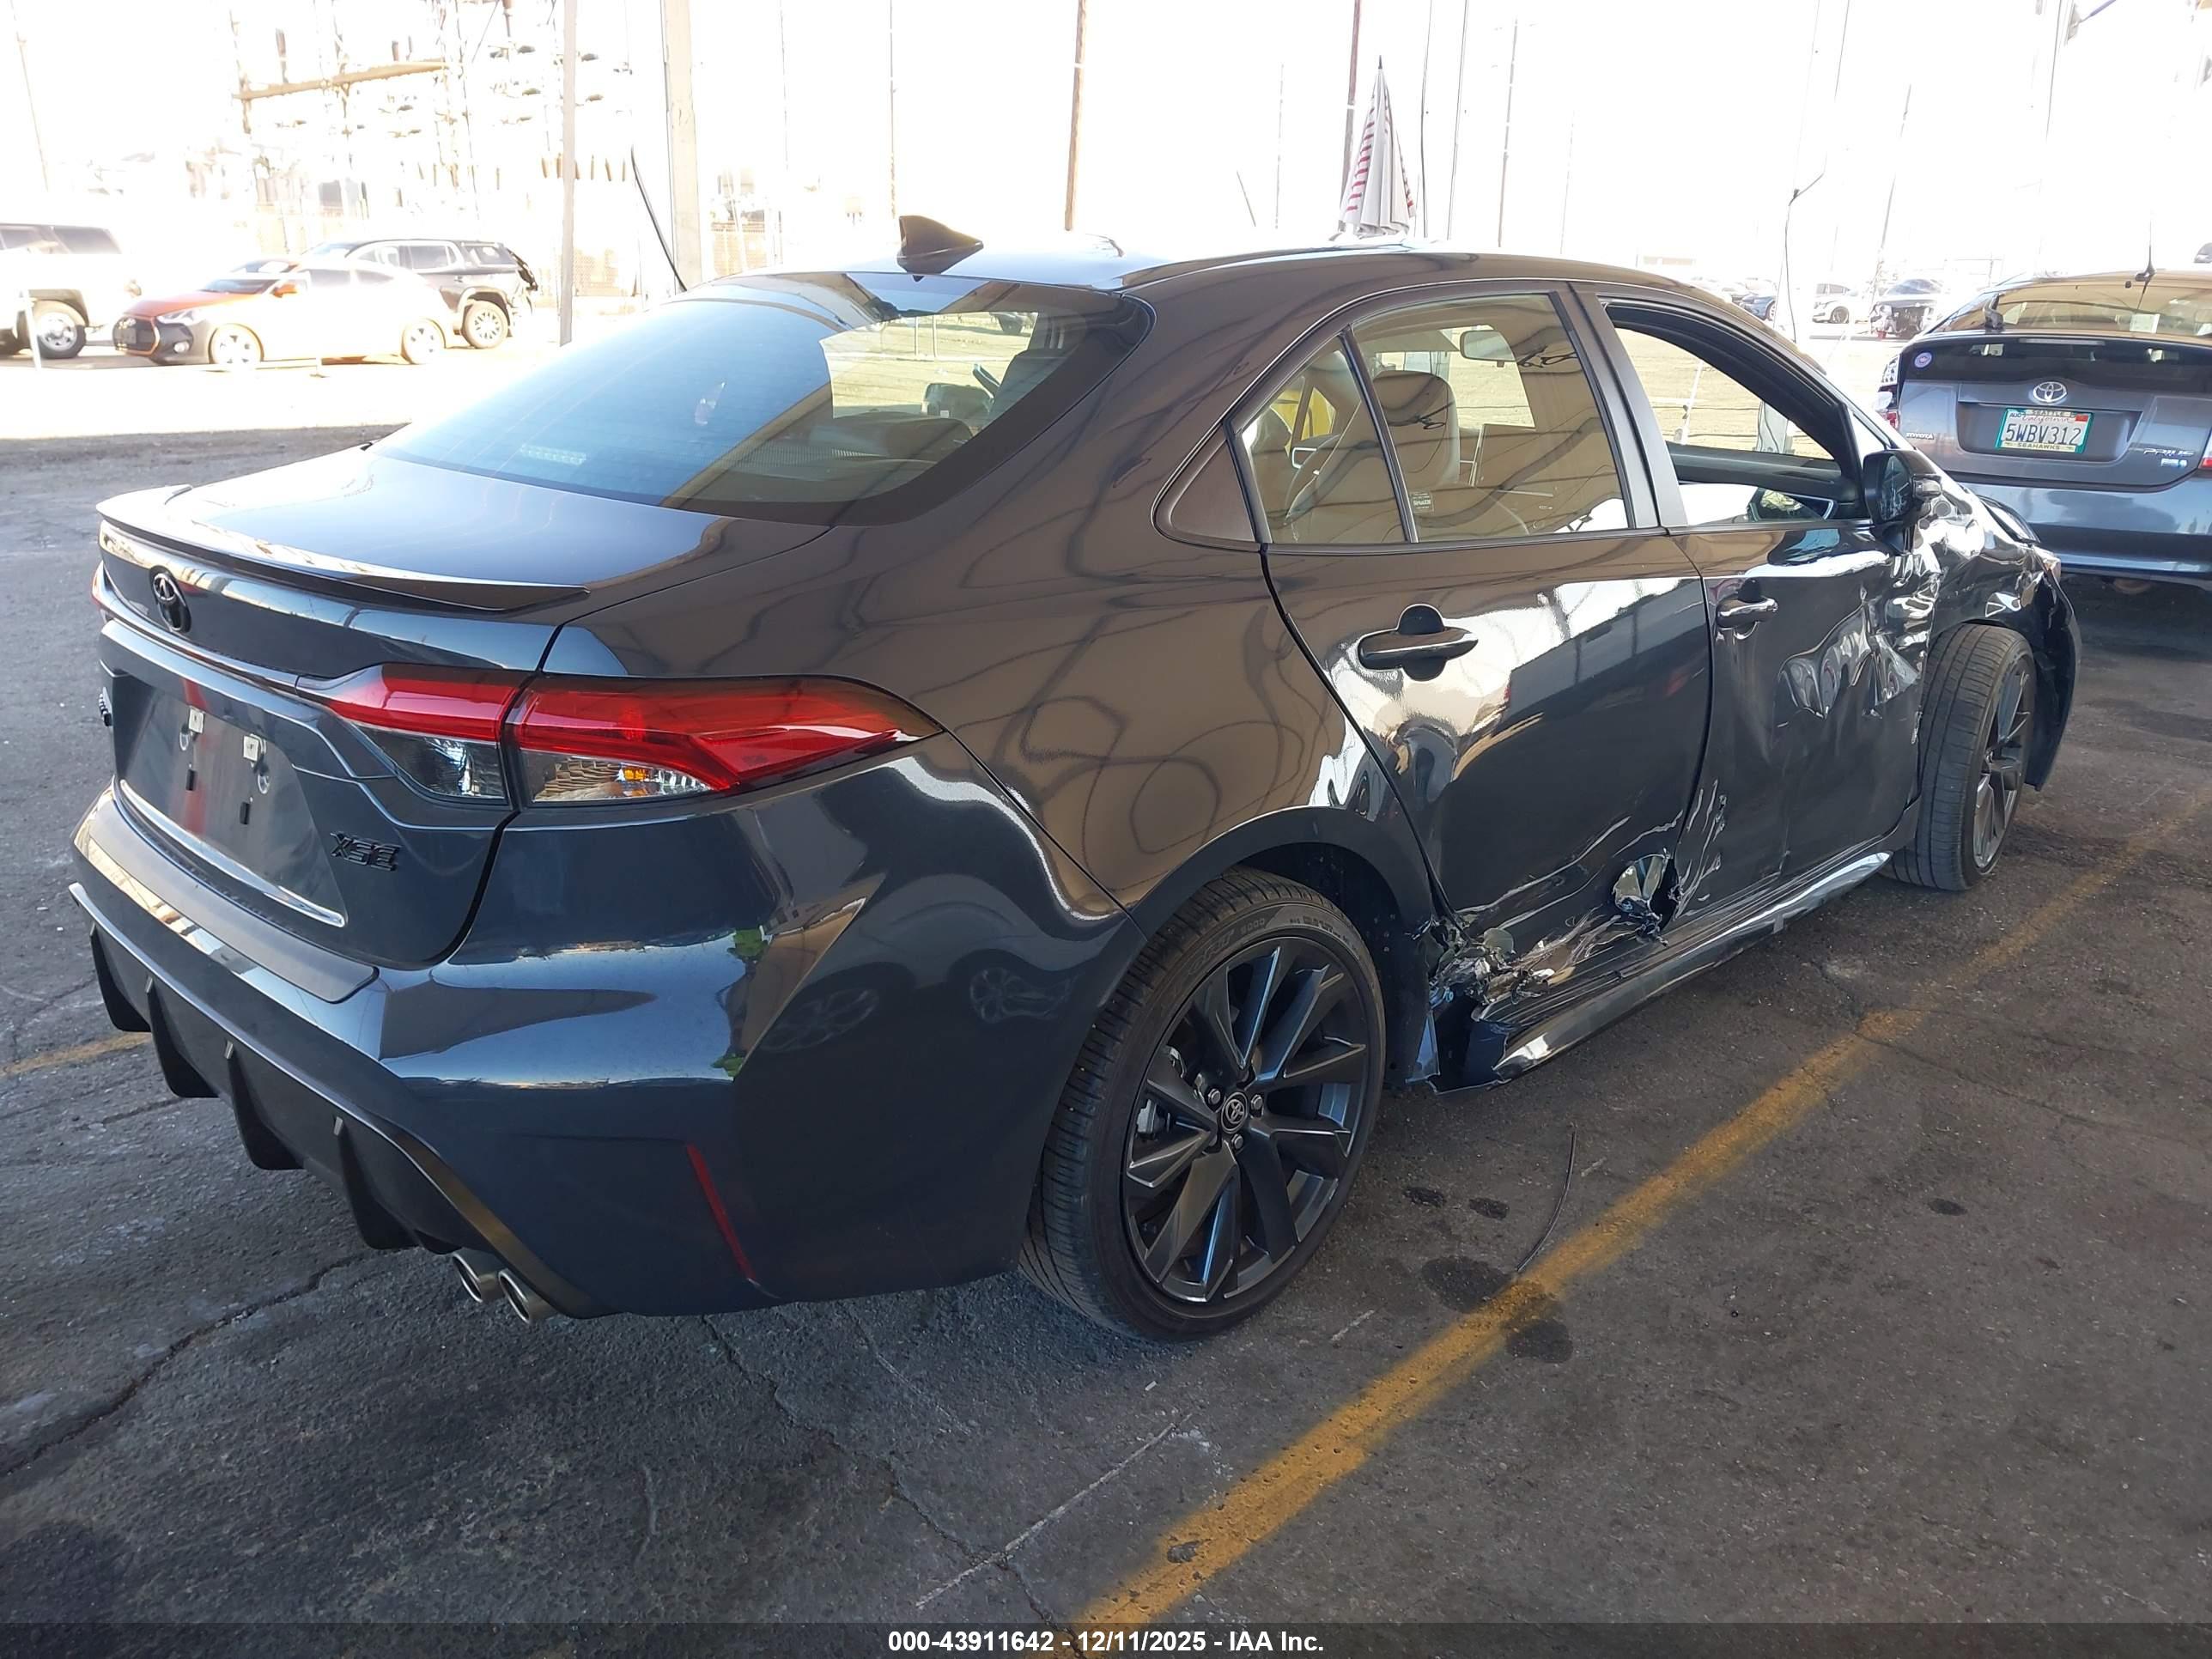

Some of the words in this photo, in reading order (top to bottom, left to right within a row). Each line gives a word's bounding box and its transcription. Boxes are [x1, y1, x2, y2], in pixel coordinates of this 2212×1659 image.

[2005, 423, 2081, 446] 5WBV312
[2143, 447, 2196, 458] PRIUS
[330, 831, 403, 872] XSE
